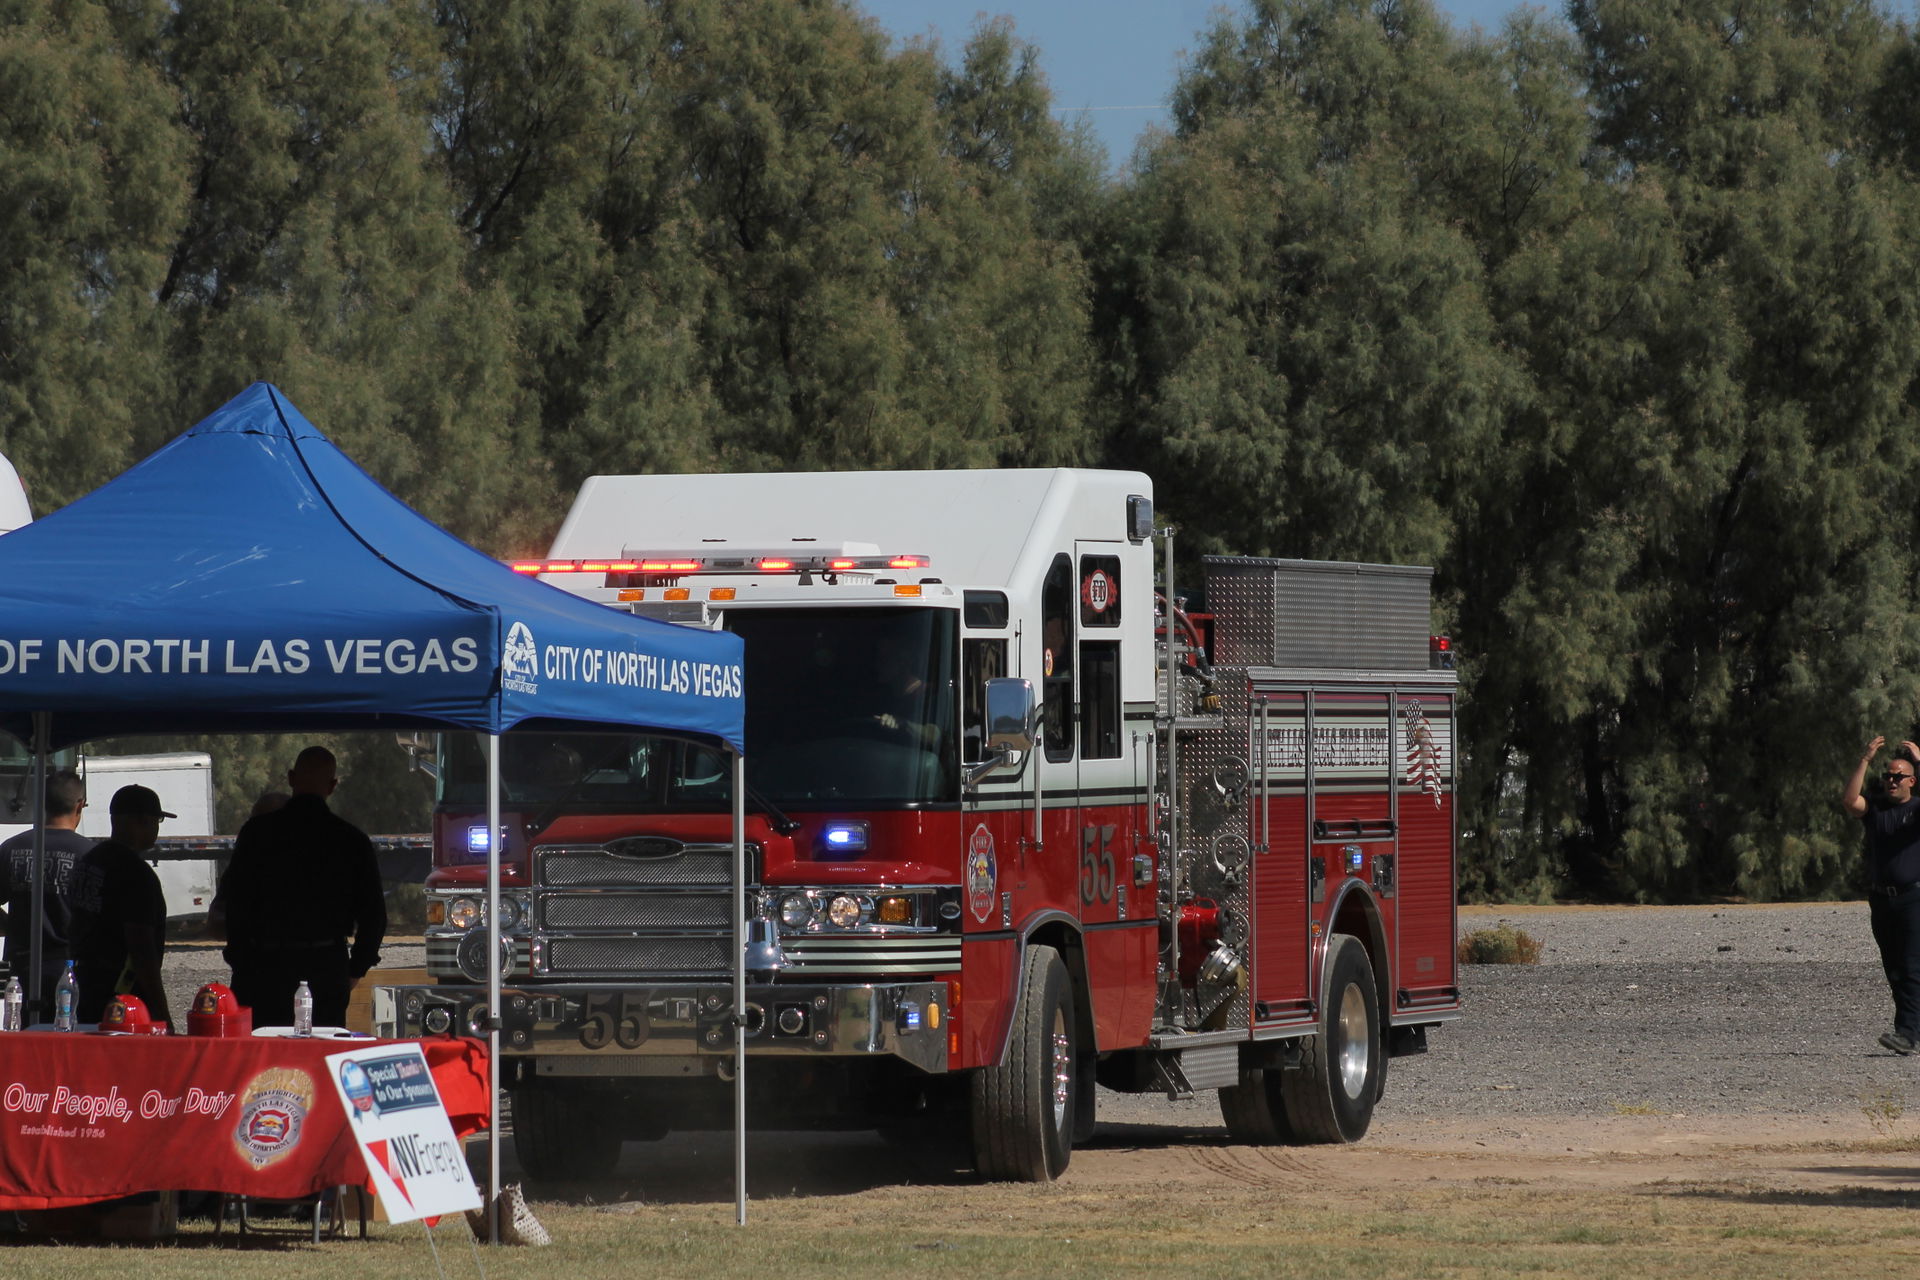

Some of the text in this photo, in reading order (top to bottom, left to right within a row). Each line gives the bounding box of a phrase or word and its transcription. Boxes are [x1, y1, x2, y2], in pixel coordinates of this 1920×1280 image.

[57, 638, 209, 674] NORTH
[225, 639, 310, 674] LAS
[324, 637, 478, 674] VEGAS
[545, 645, 741, 698] CITY OF NORTH LAS VEGAS
[1082, 825, 1115, 905] 55
[579, 992, 650, 1049] 55
[367, 1063, 398, 1086] Special
[4, 1082, 235, 1124] Our People, Our Duty
[257, 1089, 300, 1102] FIREFIGHTER
[269, 1100, 284, 1108] LAS
[375, 1089, 387, 1102] to
[385, 1084, 403, 1101] Our
[20, 1124, 106, 1139] Established 1956
